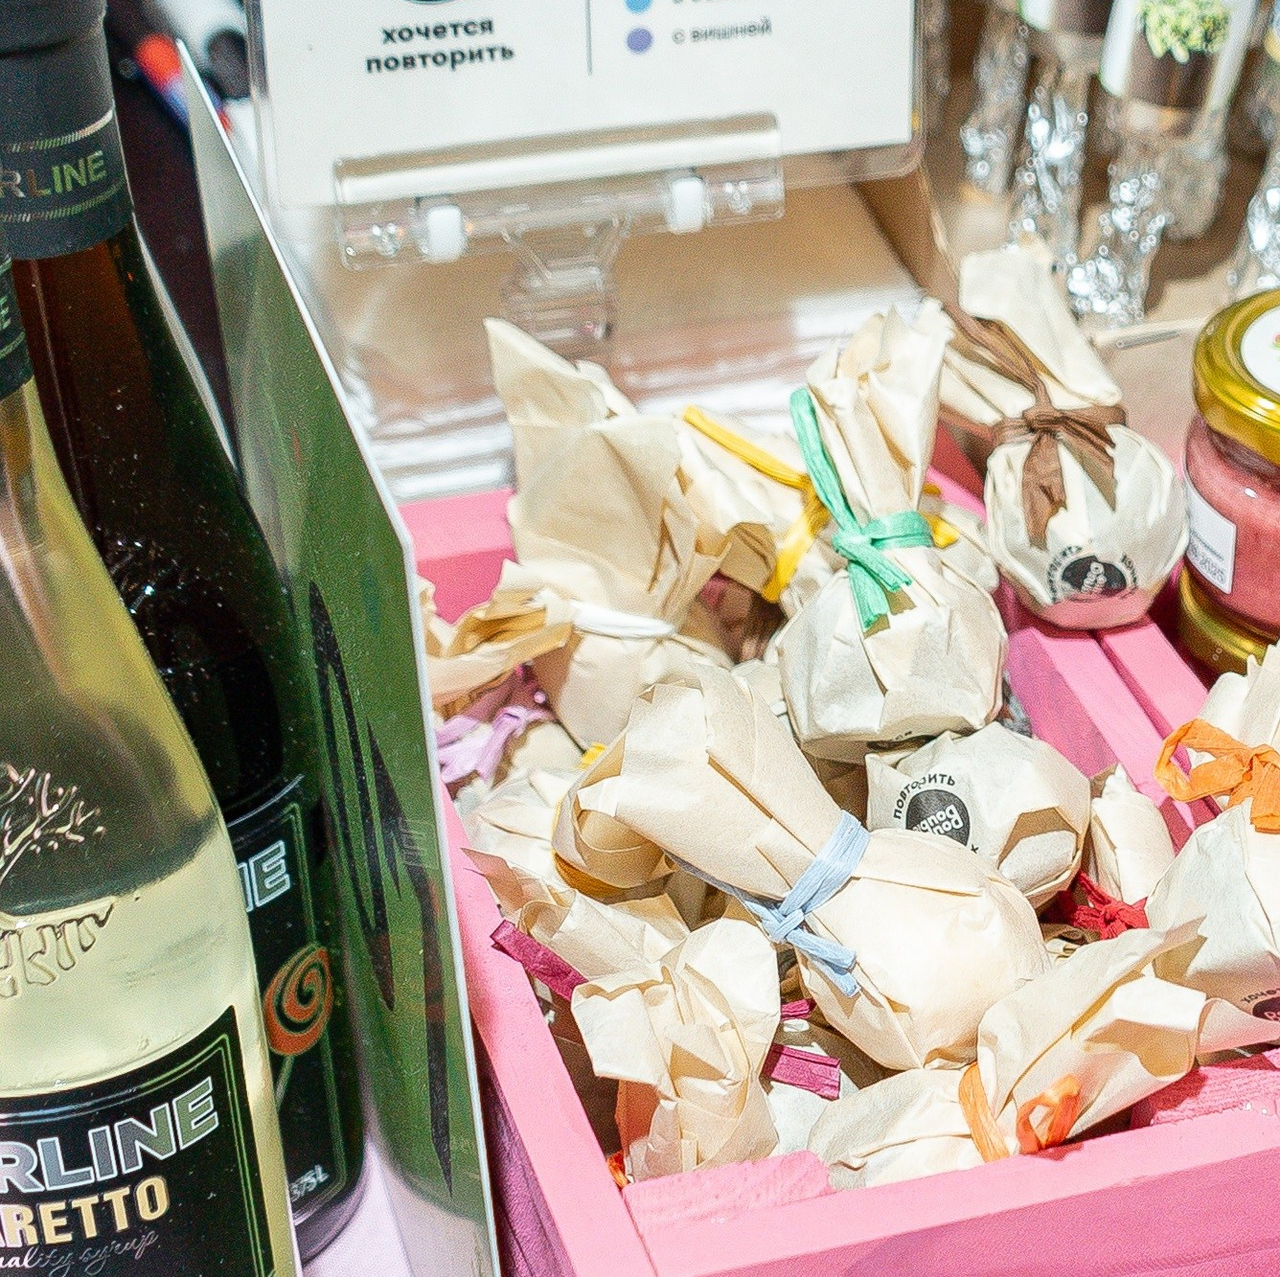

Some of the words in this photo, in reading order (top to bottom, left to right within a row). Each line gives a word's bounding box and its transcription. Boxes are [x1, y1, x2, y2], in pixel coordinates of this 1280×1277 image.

[381, 16, 494, 46] хочется
[365, 44, 514, 75] повторить
[0, 1175, 170, 1249] RETTO
